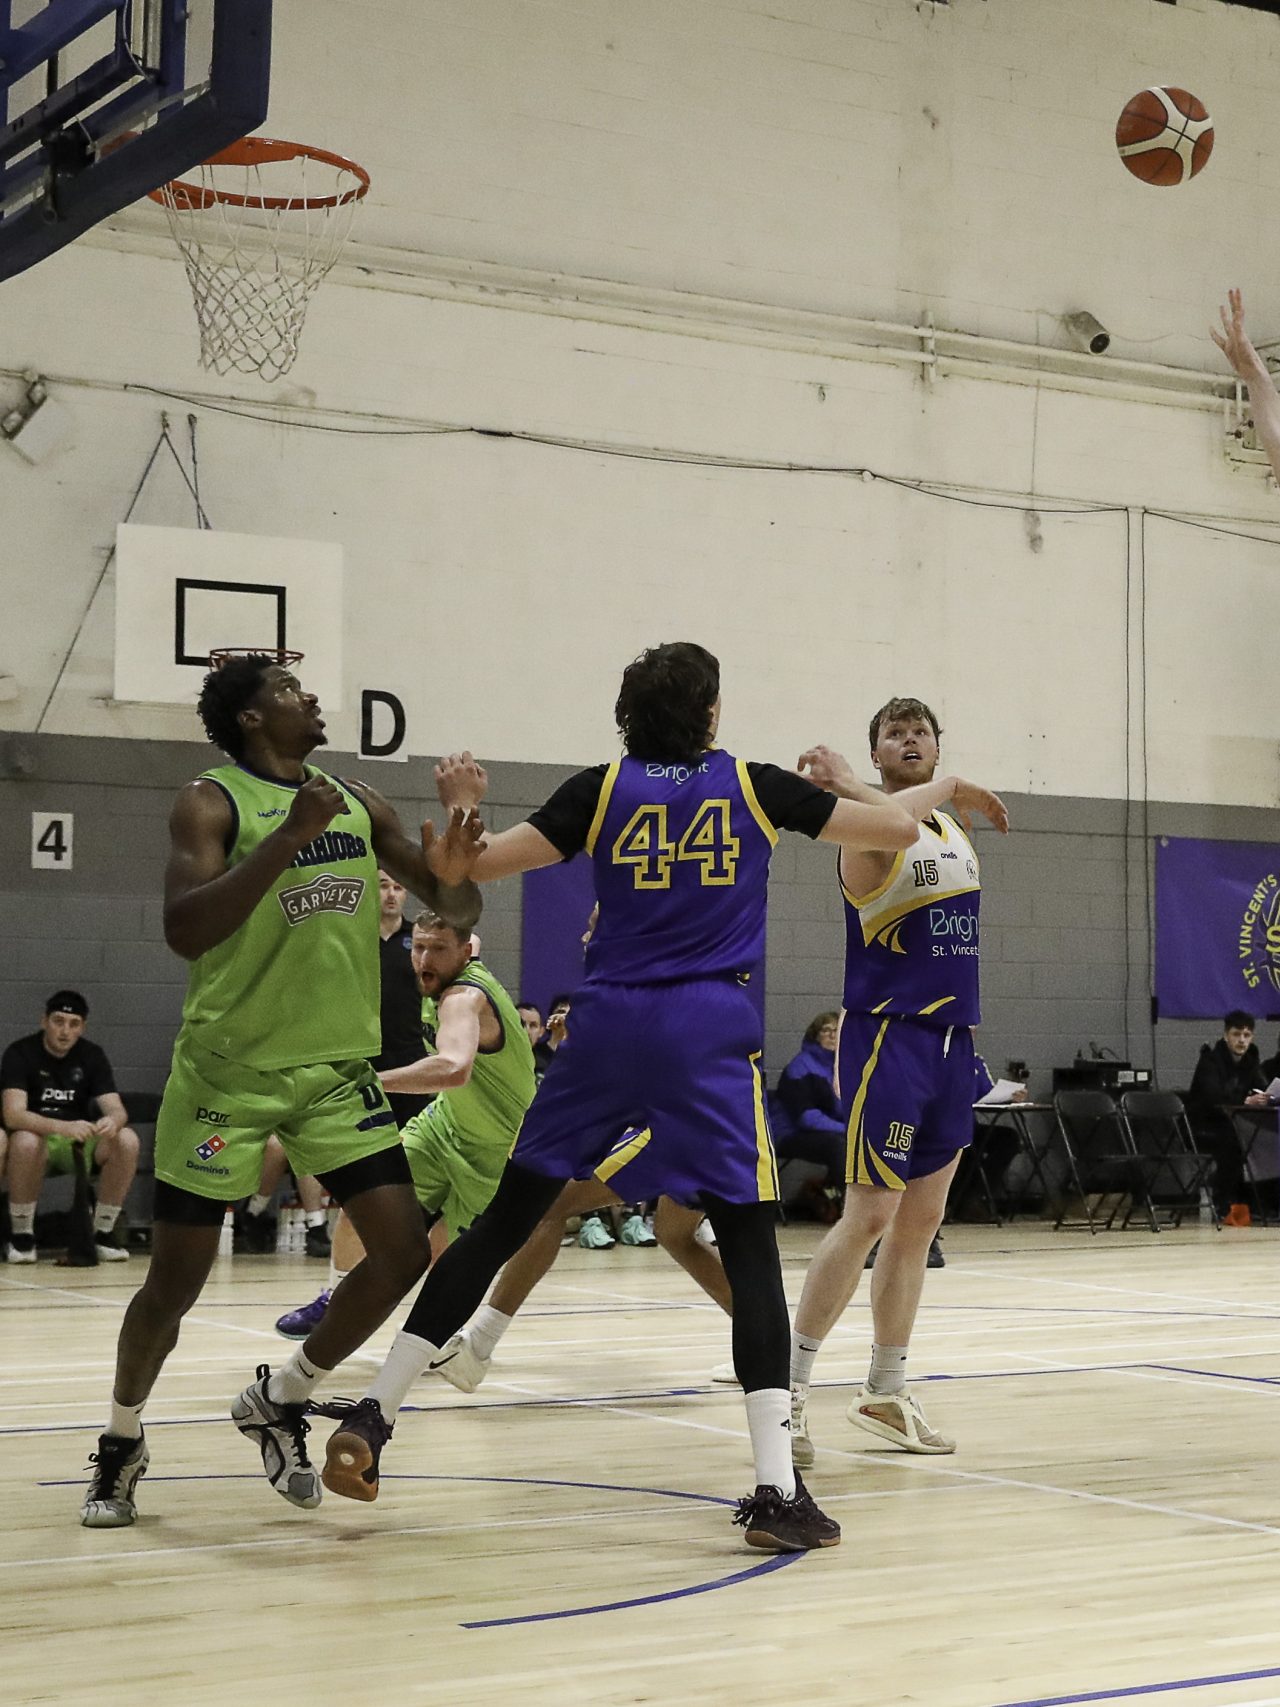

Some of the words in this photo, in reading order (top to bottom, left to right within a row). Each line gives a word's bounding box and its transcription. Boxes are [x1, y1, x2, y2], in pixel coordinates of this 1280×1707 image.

[361, 689, 406, 756] D
[646, 762, 709, 785] Brigt
[37, 820, 68, 861] 4
[612, 799, 740, 889] 44
[912, 860, 939, 887] 15
[287, 888, 358, 915] GARVEY'S
[930, 908, 979, 942] Brigh
[1239, 874, 1277, 958] VINCENT'S
[932, 945, 948, 956] St.
[1242, 961, 1260, 988] ST.
[196, 1107, 231, 1124] parr
[885, 1121, 915, 1152] 15
[186, 1159, 229, 1177] Domino's
